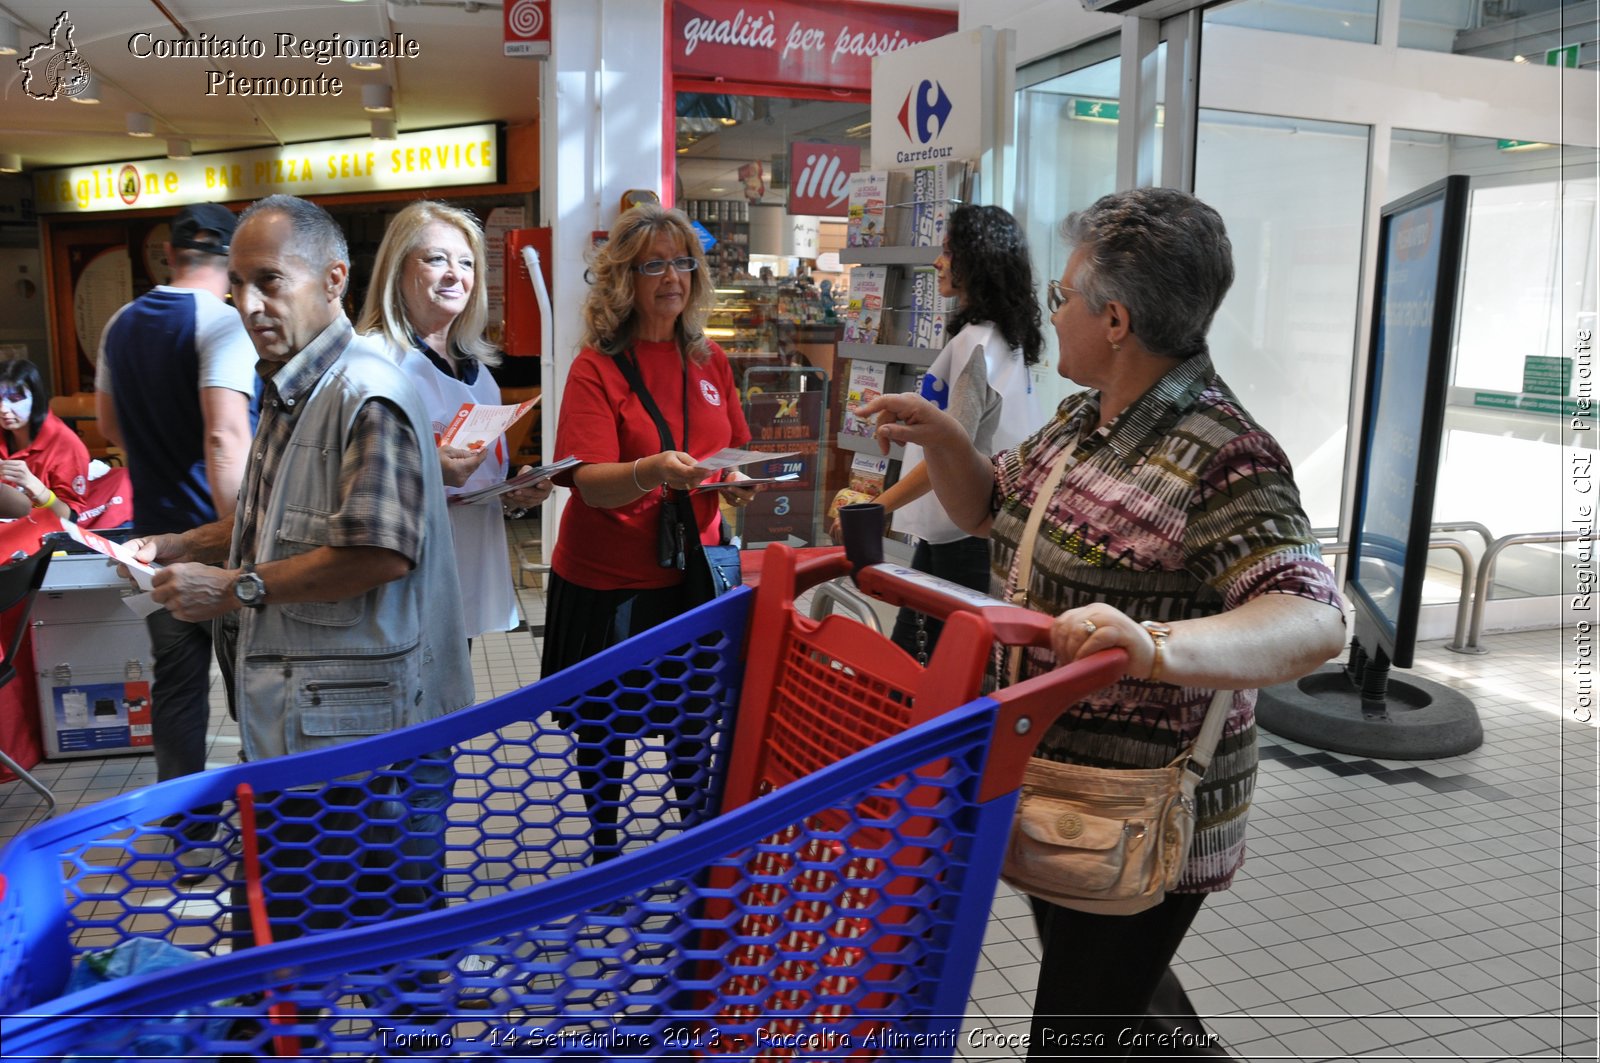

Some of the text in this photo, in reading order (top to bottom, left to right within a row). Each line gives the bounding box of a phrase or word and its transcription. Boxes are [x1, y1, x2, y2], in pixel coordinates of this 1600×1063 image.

[684, 8, 776, 56] qualità
[782, 21, 826, 59] per
[205, 164, 242, 189] BAR
[255, 158, 313, 185] PIZZA
[327, 152, 375, 180] SELF
[392, 140, 491, 174] SERVICE
[897, 146, 953, 163] Carrefour
[796, 154, 850, 209] illy
[783, 462, 803, 472] TIM
[773, 496, 790, 516] 3
